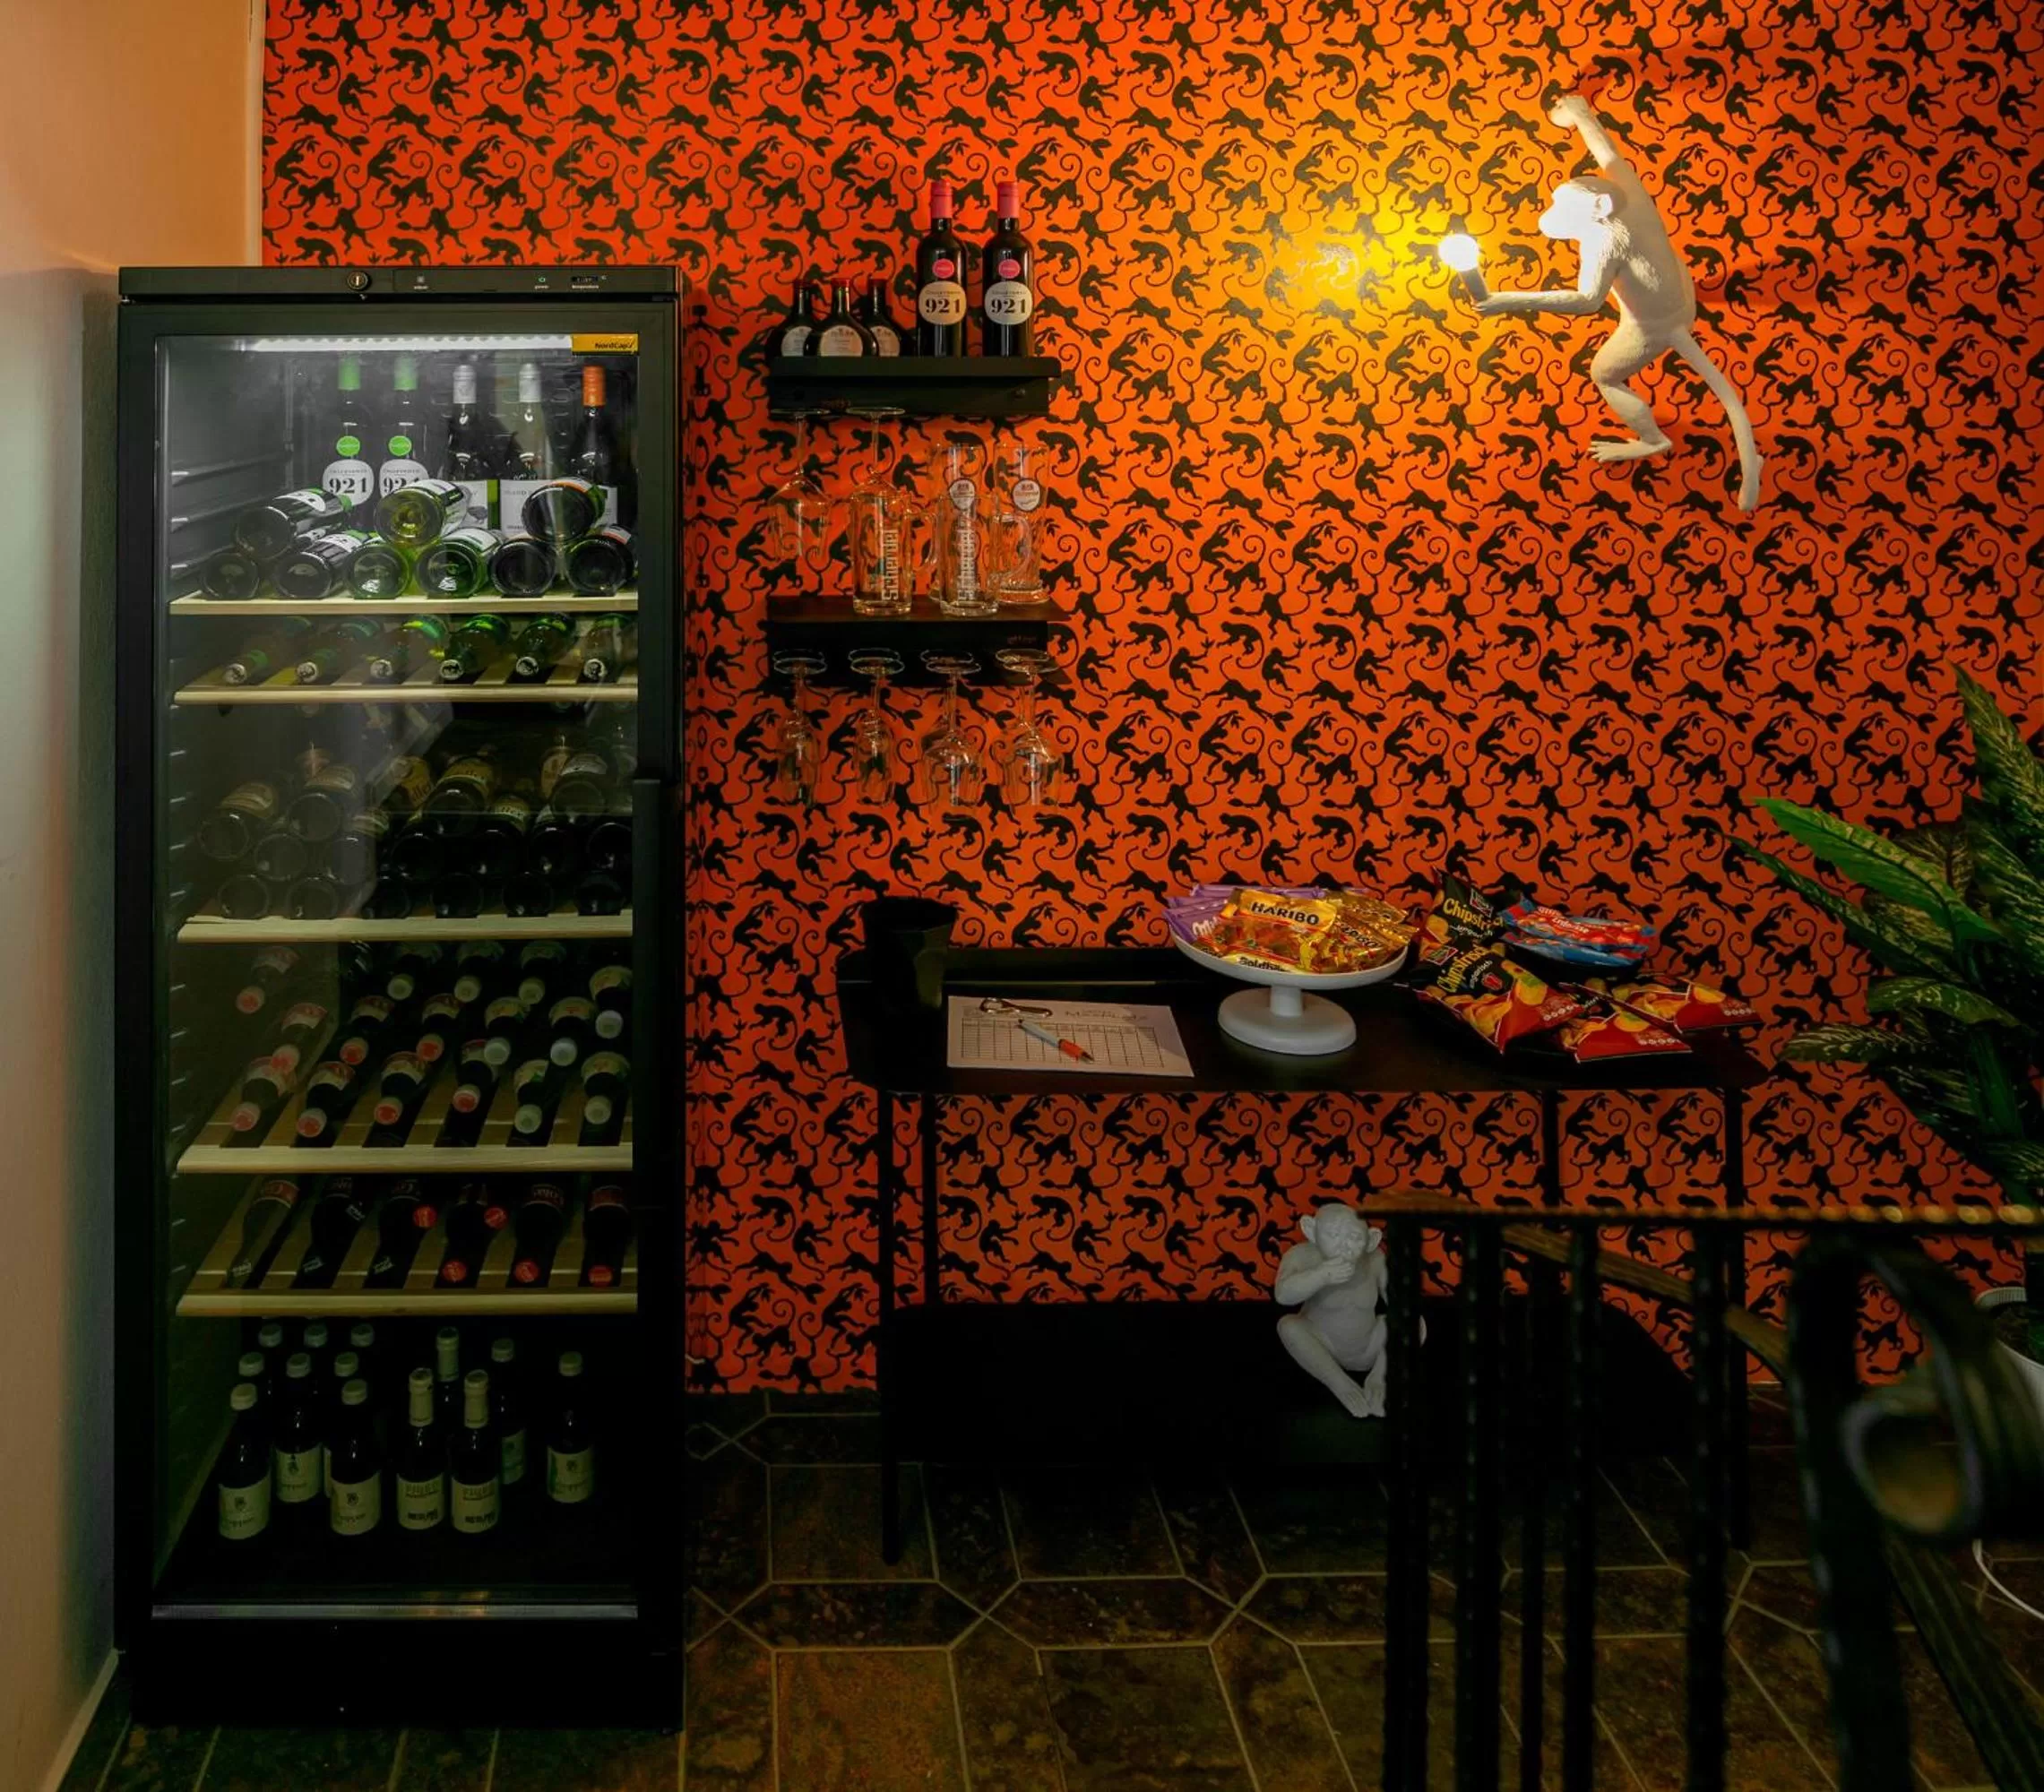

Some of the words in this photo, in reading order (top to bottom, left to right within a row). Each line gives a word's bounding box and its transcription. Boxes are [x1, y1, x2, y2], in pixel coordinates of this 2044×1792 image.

[926, 298, 961, 314] 921
[991, 298, 1026, 314] 921
[329, 478, 367, 494] 921
[881, 530, 899, 600] Scherdel
[1251, 901, 1319, 925] HARIBO
